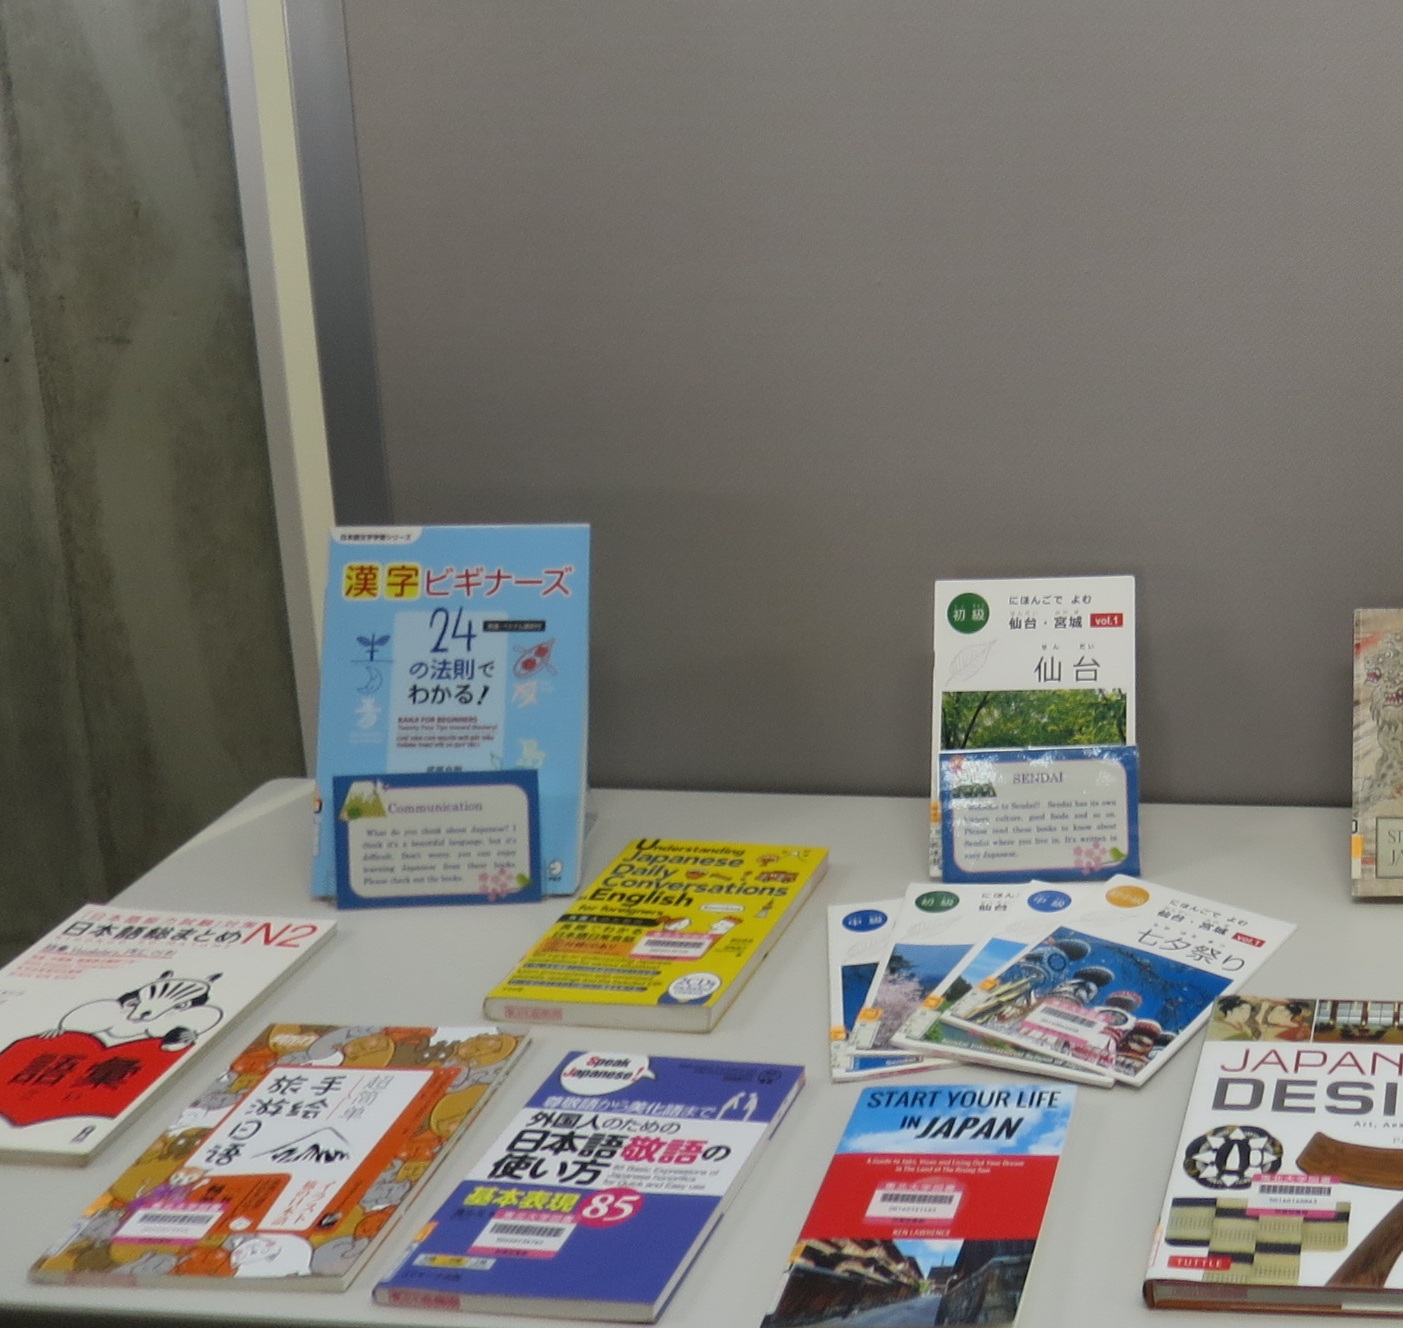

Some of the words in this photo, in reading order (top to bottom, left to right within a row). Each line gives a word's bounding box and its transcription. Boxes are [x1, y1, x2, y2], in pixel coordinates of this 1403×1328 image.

[344, 564, 574, 598] 漢字ビギナーズ
[1009, 596, 1063, 606] にほんごで
[1071, 595, 1092, 605] よむ
[953, 608, 985, 622] 初級
[1009, 616, 1083, 630] 仙台・宮城
[1094, 615, 1119, 626] vol.1
[429, 605, 477, 653] 24
[409, 659, 494, 680] の法則で
[1034, 655, 1101, 683] 仙台
[1013, 772, 1063, 785] SENDAI
[388, 801, 483, 815] Communication
[635, 838, 746, 856] Understanding
[622, 850, 744, 869] Japanese
[612, 864, 678, 882] Daily
[600, 876, 789, 898] Conversations
[589, 888, 694, 910] English
[62, 921, 242, 944] 日本語総まとめ
[242, 922, 318, 949] N2
[1137, 928, 1246, 972] 七夕祭り
[586, 1055, 632, 1068] Speak
[867, 1091, 941, 1109] START
[947, 1091, 1011, 1109] YOUR
[1015, 1091, 1061, 1109] LIFE
[526, 1112, 681, 1134] 外国人のための
[901, 1116, 921, 1129] IN
[914, 1117, 1023, 1140] JAPAN
[1353, 1121, 1377, 1130] Art,
[505, 1128, 732, 1166] 日本語敬語の
[487, 1154, 613, 1186] 使い方
[463, 1186, 582, 1213] 基本表現
[582, 1194, 642, 1222] 85
[1175, 1257, 1223, 1269] TUTTLE
